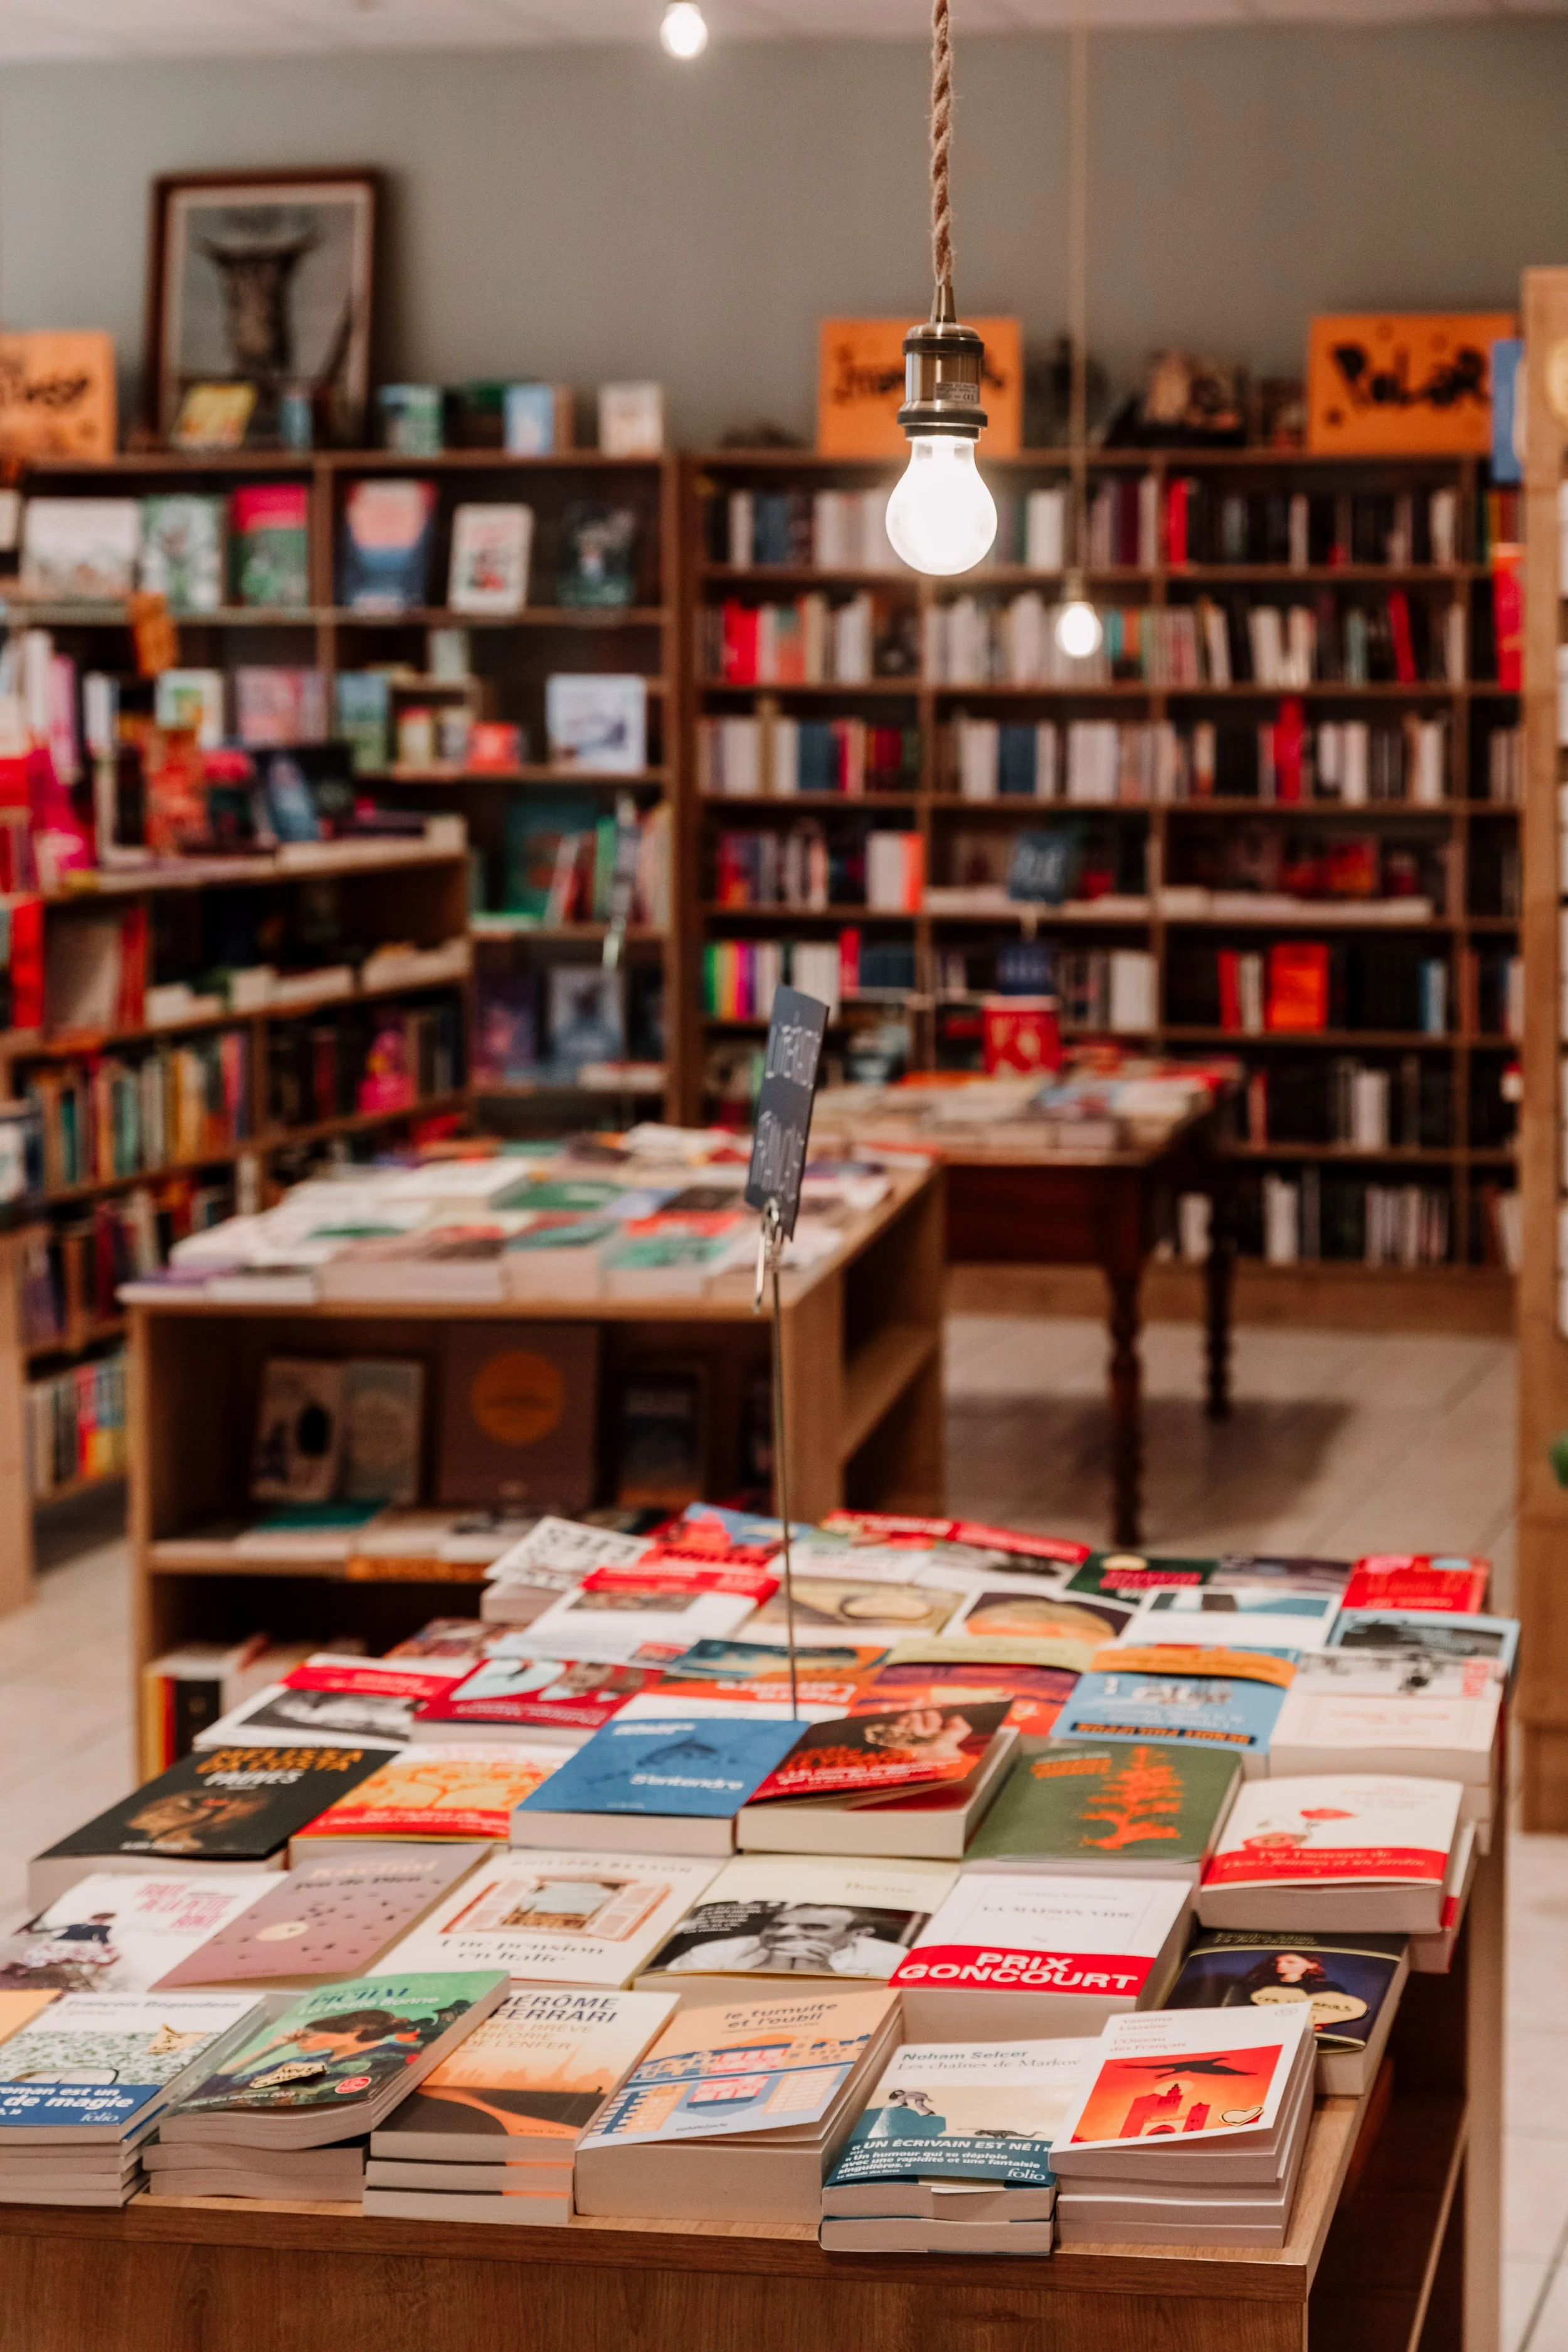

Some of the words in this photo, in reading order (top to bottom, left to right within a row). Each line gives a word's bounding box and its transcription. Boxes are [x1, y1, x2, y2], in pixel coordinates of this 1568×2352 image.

[1012, 1906, 1085, 1916] MAISON
[975, 1951, 1074, 1973] PRIX
[898, 1963, 1138, 1989] GONCOURT
[379, 1996, 440, 2006] Bonne
[504, 1994, 620, 2010] JÉRÔME
[492, 2008, 620, 2023] FERRARI
[724, 2012, 743, 2020] le
[751, 2003, 839, 2018] tumulte
[728, 2019, 750, 2028] et
[757, 2012, 824, 2026] l'oubli
[494, 2040, 571, 2050] L'ENFER
[902, 2052, 966, 2062] Noham
[971, 2050, 1029, 2060] Selcer
[993, 2060, 1011, 2069] de
[1018, 2058, 1082, 2068] Markov
[0, 2086, 56, 2095] oman
[60, 2087, 92, 2096] est
[94, 2088, 120, 2096] un
[3, 2095, 41, 2107] de
[45, 2095, 135, 2111] magie
[79, 2111, 119, 2122] folio
[863, 2139, 890, 2149] UN
[892, 2138, 971, 2149] ÉCRIVAIN
[975, 2141, 1006, 2151] EST
[1009, 2141, 1032, 2152] NÉ
[841, 2160, 870, 2169] avec
[896, 2155, 944, 2165] rapidité
[988, 2158, 1041, 2169] fantaisie
[854, 2153, 871, 2161] Un
[872, 2151, 921, 2159] humour
[923, 2150, 943, 2159] qui
[958, 2151, 1008, 2161] déploie
[837, 2163, 903, 2175] singulières.
[1005, 2167, 1046, 2181] folio
